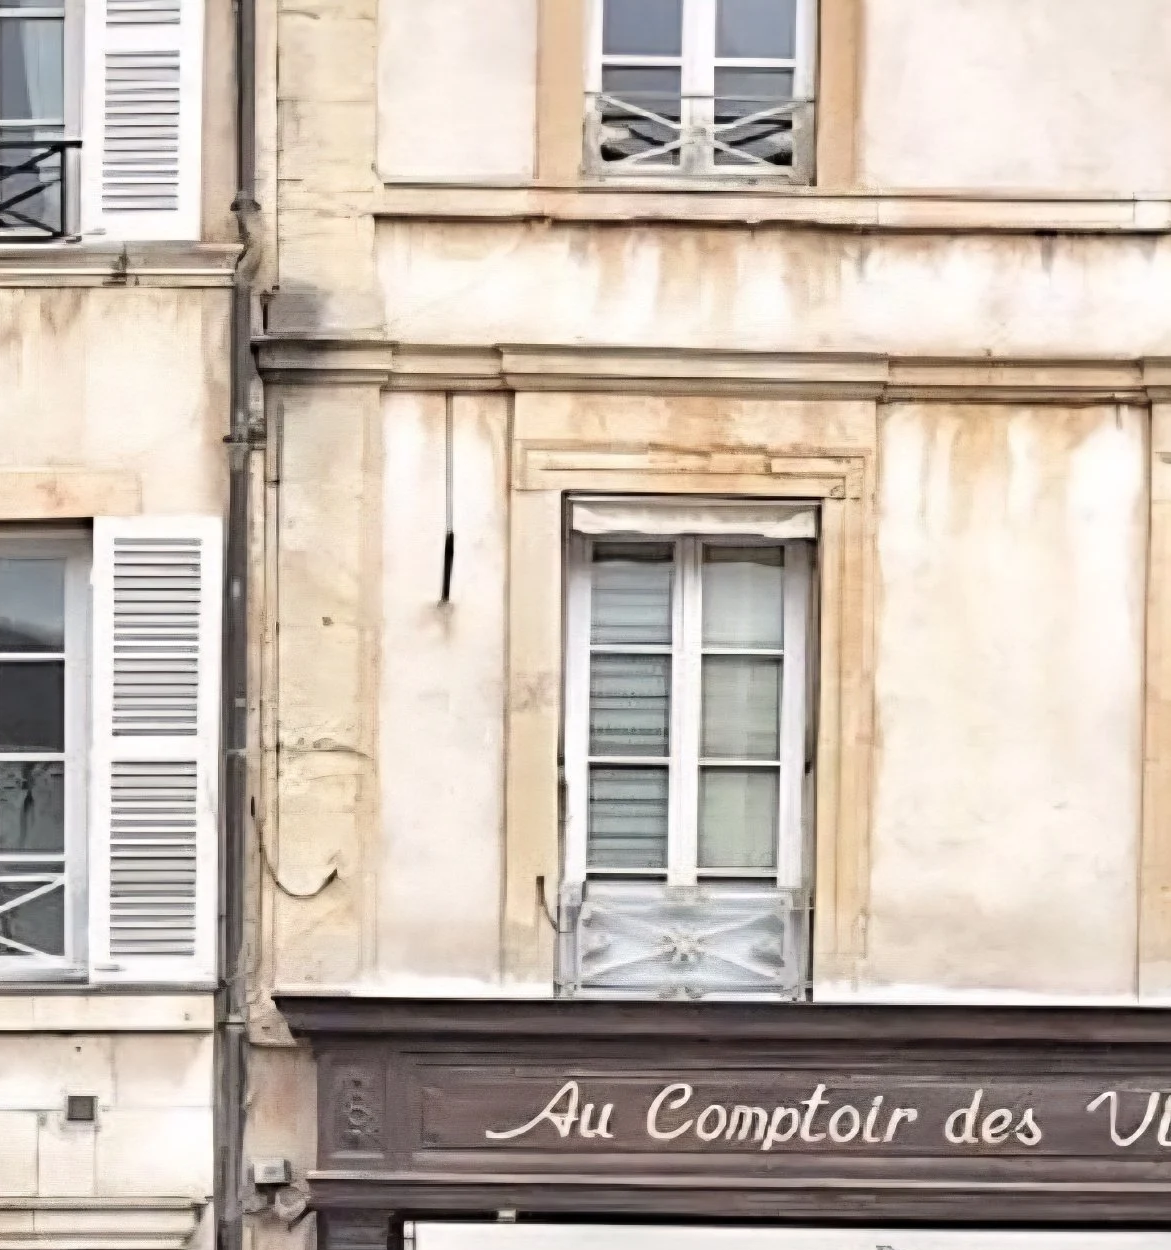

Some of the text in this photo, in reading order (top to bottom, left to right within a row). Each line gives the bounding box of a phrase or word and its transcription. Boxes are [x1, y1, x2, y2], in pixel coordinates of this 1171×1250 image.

[485, 1080, 614, 1139] Au
[646, 1083, 918, 1151] Comptoir
[944, 1088, 1043, 1147] des
